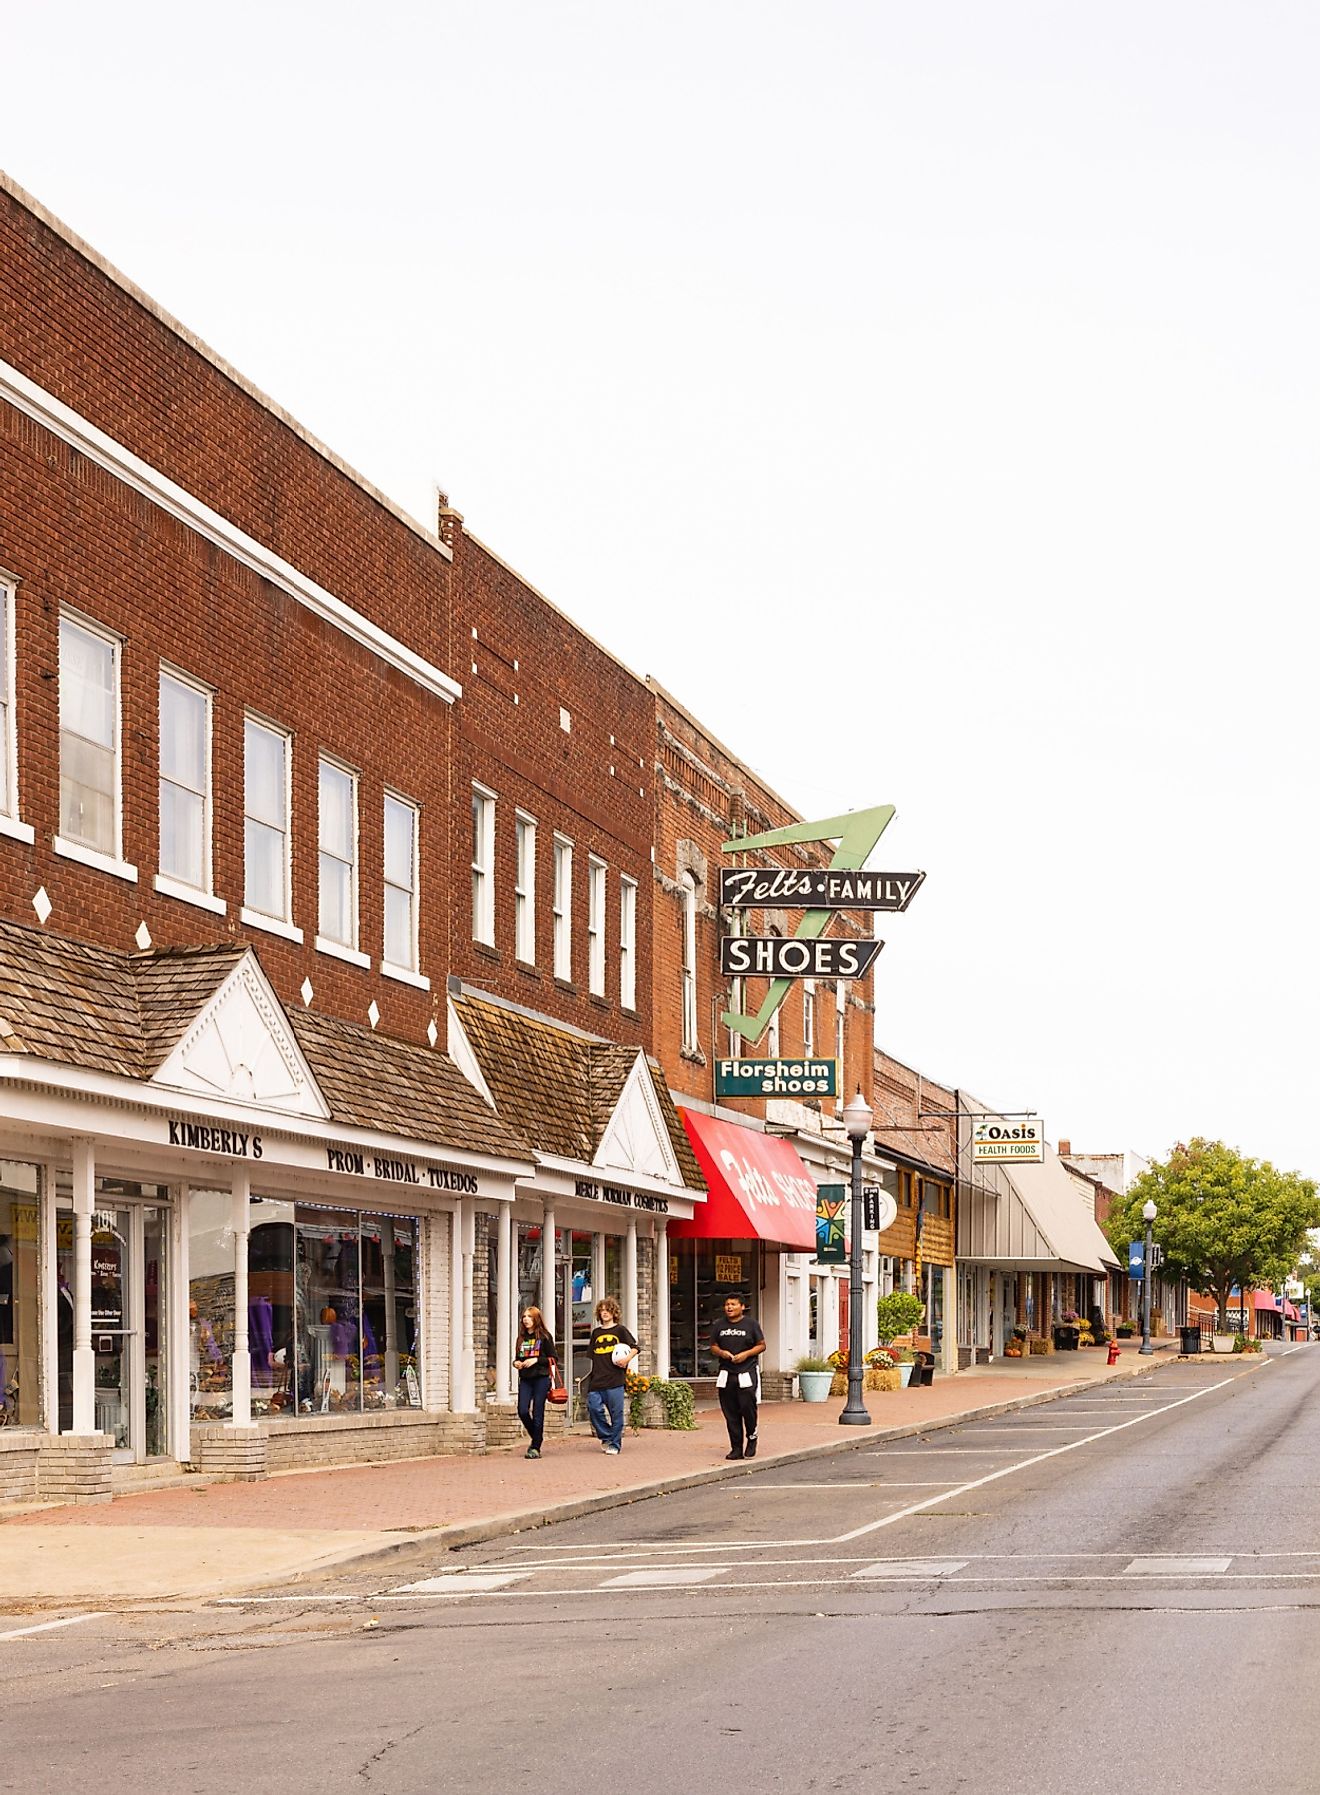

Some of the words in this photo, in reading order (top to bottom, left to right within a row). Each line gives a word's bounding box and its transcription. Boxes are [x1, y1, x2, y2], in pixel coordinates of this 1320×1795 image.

[725, 870, 812, 904] Felts
[829, 879, 911, 901] FAMILY
[728, 939, 859, 975] SHOES
[721, 1060, 830, 1078] Florsheim
[761, 1077, 830, 1092] shoes
[1010, 1145, 1036, 1154] FOODS
[327, 1148, 364, 1175] PROM
[374, 1158, 420, 1184] BRIDAL
[427, 1168, 478, 1194] TUXEDOS
[634, 1193, 669, 1213] COSMETICS
